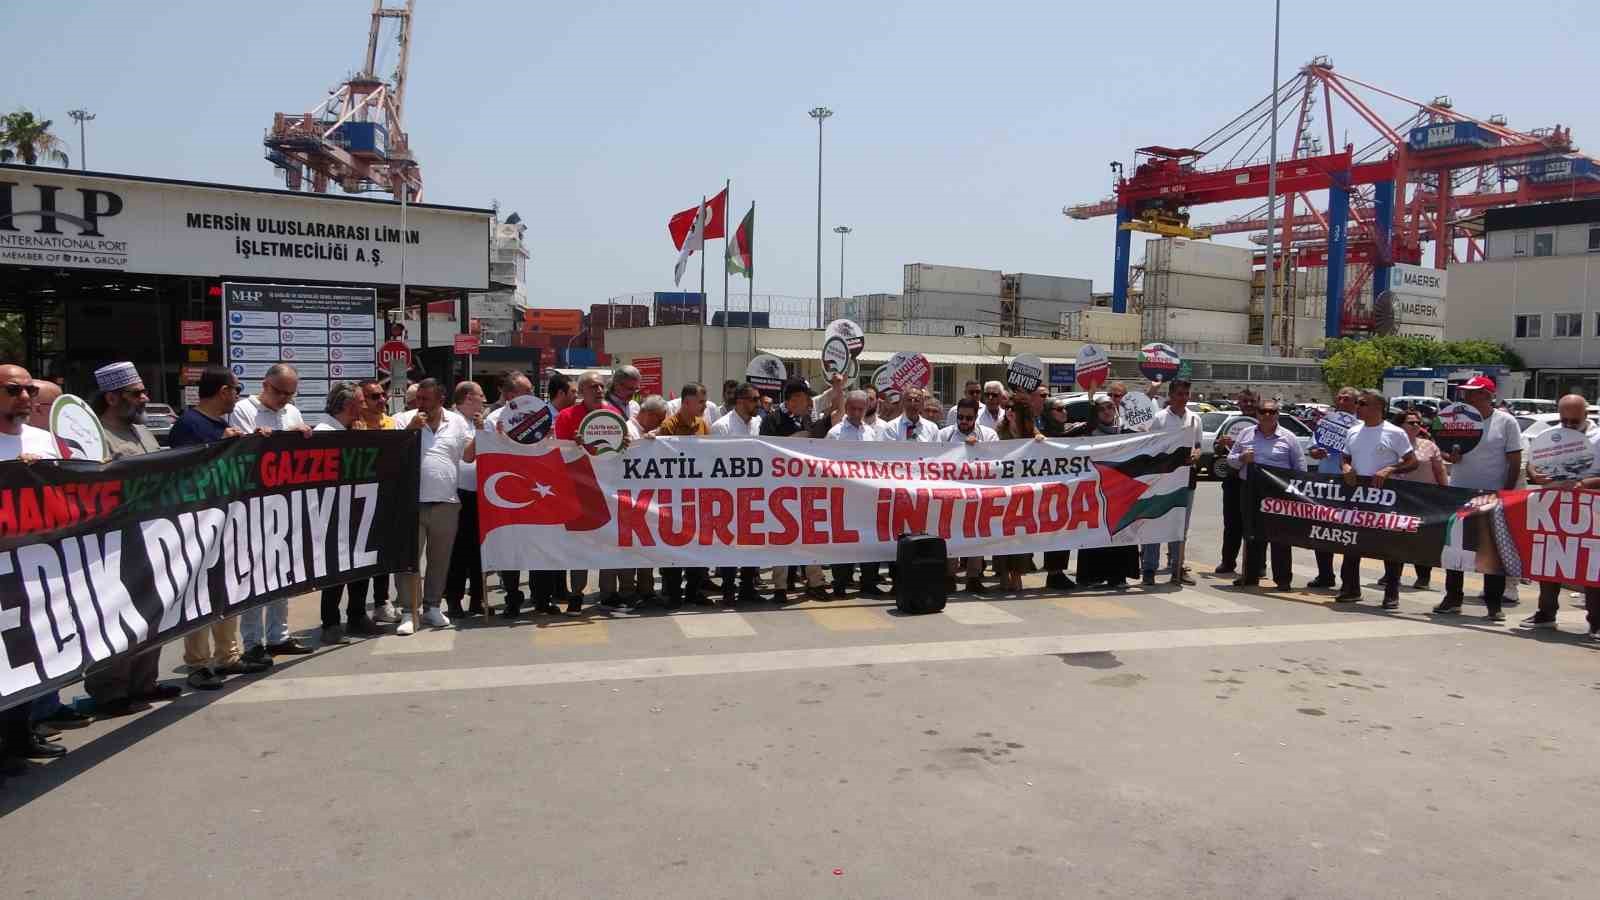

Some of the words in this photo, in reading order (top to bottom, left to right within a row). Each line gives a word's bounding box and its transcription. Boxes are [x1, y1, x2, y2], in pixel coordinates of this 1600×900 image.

[186, 212, 250, 232] MERSİN
[257, 218, 370, 241] ULUSLARARASI
[375, 224, 420, 244] LİMAN
[2, 251, 43, 261] MEMBER
[46, 253, 61, 262] OF
[94, 256, 128, 266] GROUP
[98, 240, 128, 251] PORT
[236, 236, 348, 261] İŞLETMECİLİĞİ
[356, 247, 384, 266] A.Ş.
[1403, 273, 1441, 289] MAERSK
[1401, 303, 1439, 318] MAERSK
[622, 452, 702, 480] KATİL
[710, 457, 764, 479] ABD
[771, 456, 914, 481] SOYKIRIMCI
[917, 456, 1015, 481] İSRAİL'E
[1021, 455, 1093, 480] KARŞI
[1284, 478, 1347, 502] KATİL
[1350, 485, 1398, 507] ABD
[617, 486, 860, 548] KÜRESEL
[877, 480, 1101, 543] İNTİFADA
[1261, 497, 1347, 524] SOYKIRIMCI
[1308, 525, 1359, 547] KARŞI
